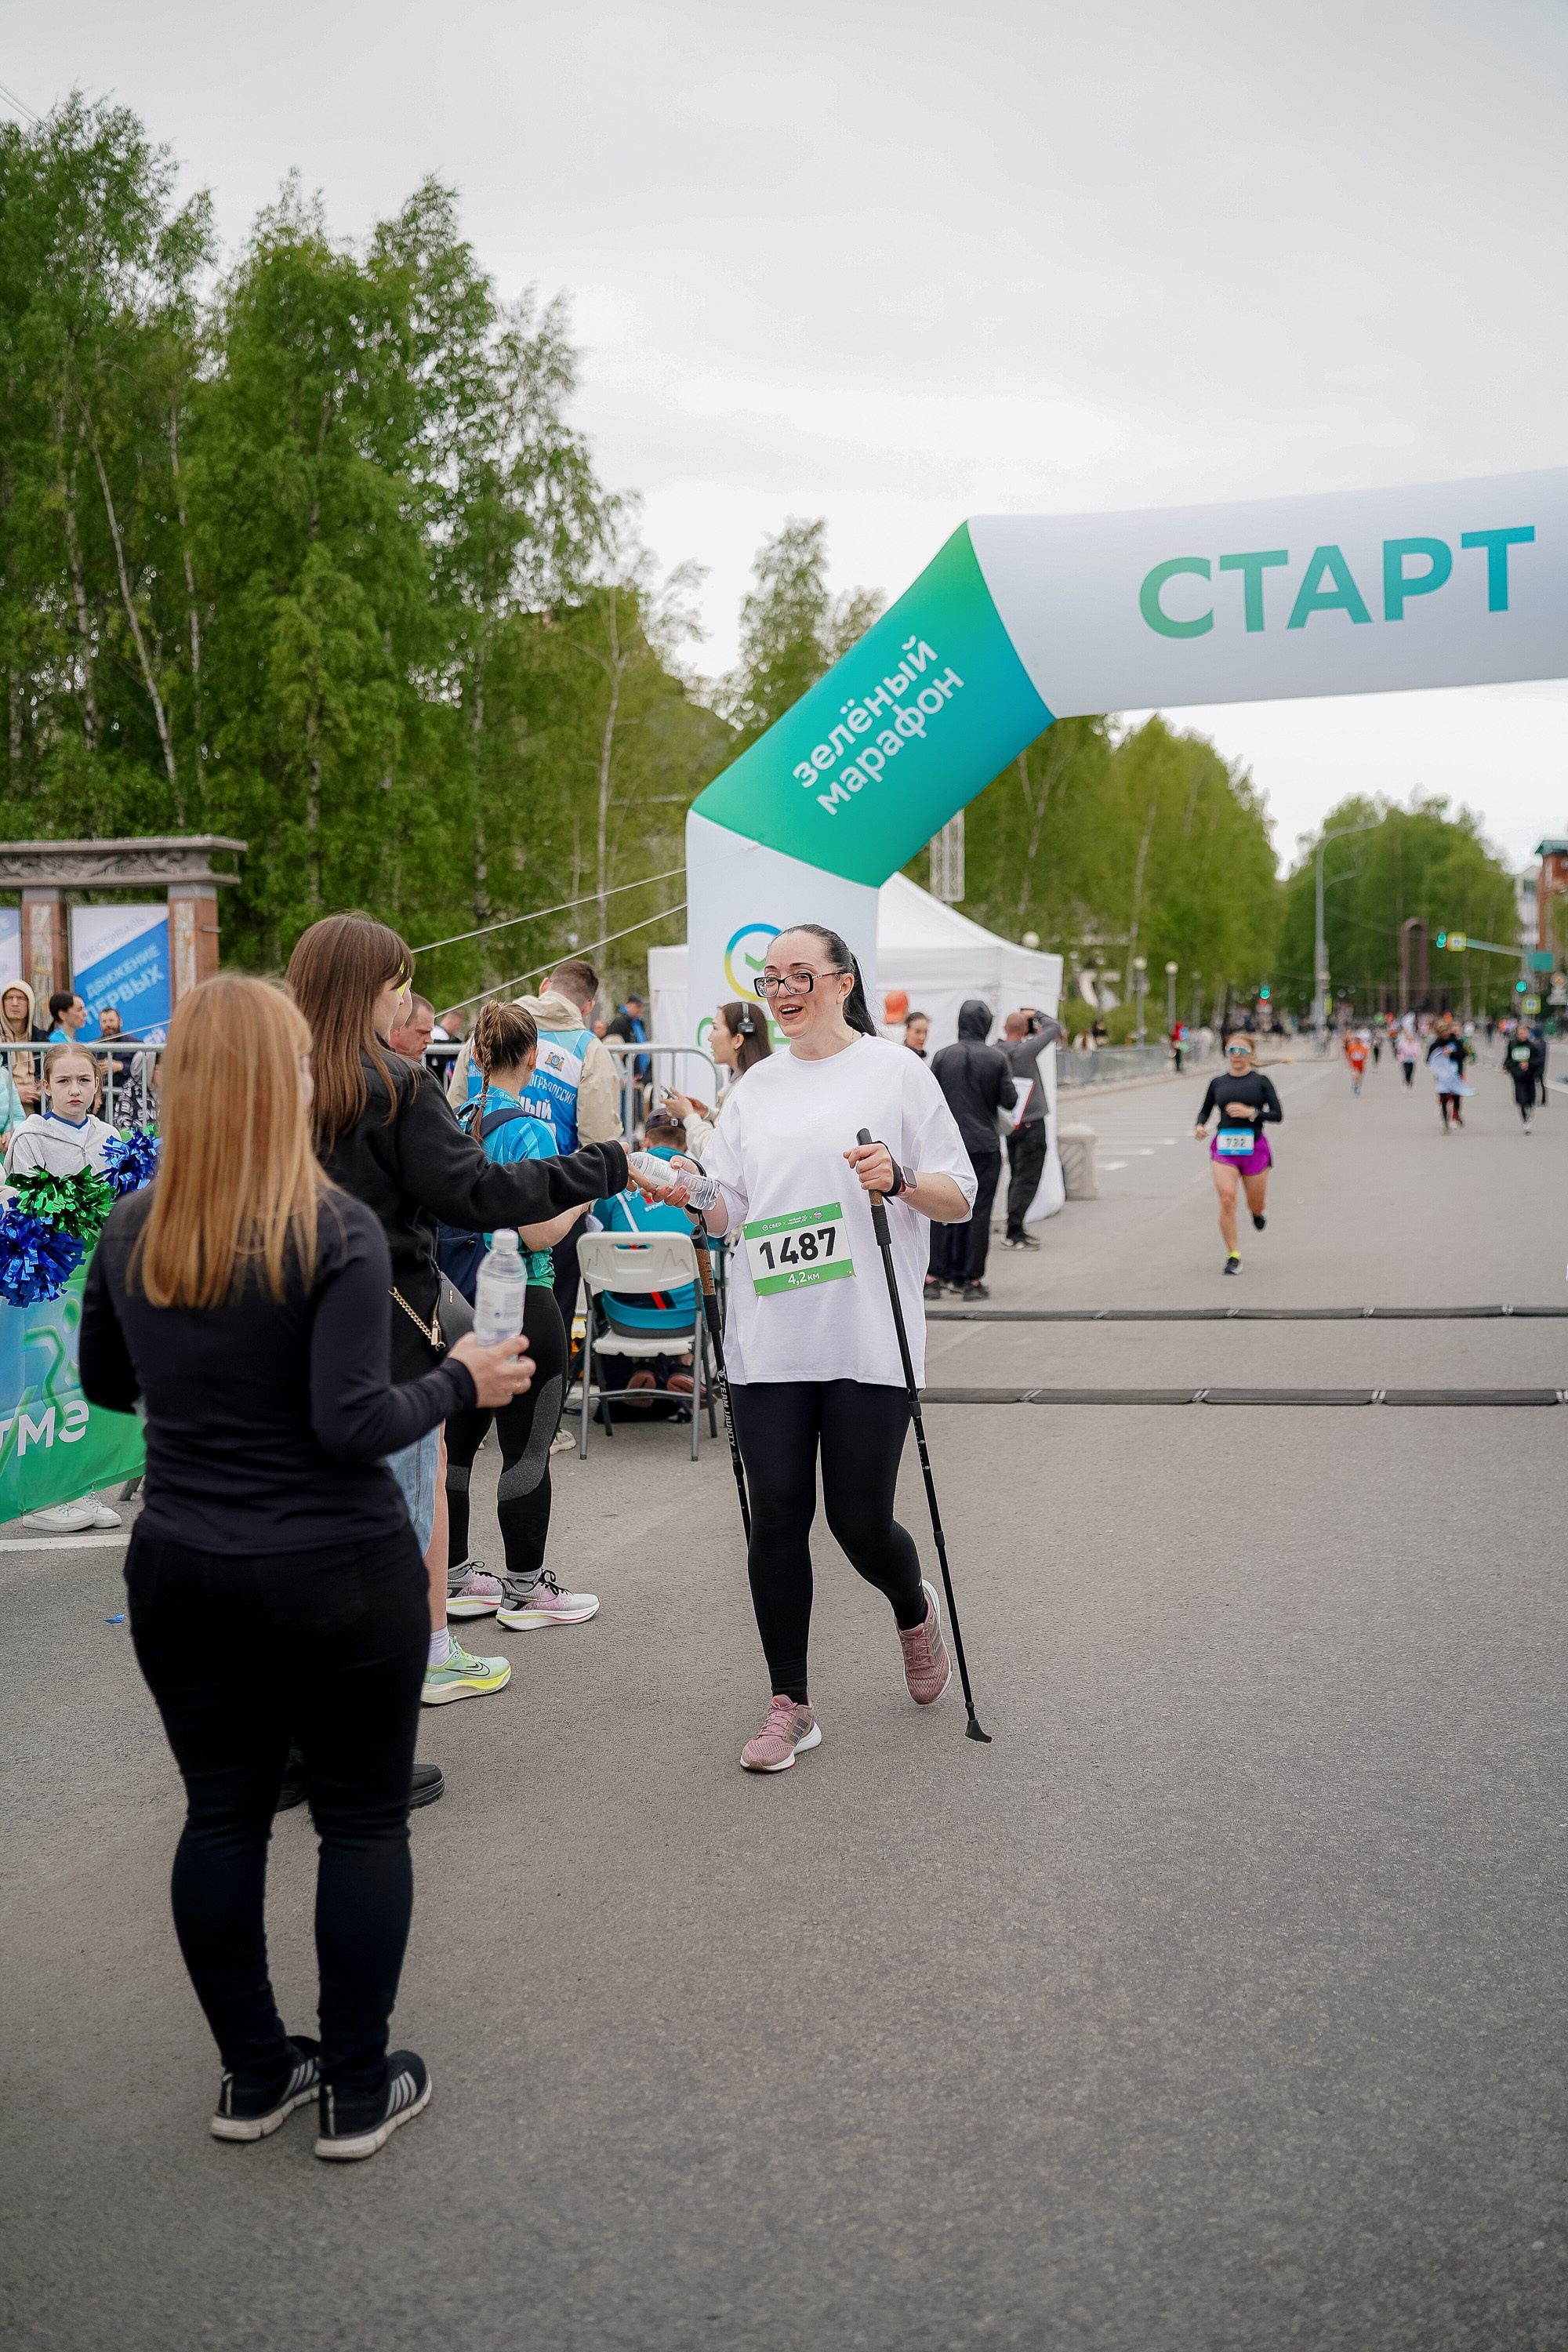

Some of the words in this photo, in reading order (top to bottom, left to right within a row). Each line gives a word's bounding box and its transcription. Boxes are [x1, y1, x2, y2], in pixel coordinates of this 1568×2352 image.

[1138, 525, 1536, 640] СТАРТ
[793, 634, 938, 789] зелёный
[816, 667, 965, 816] марафон
[85, 943, 162, 1001] ДВИЖЕНИЕ
[85, 963, 165, 1025] ПЕРВЫХ
[759, 1226, 837, 1270] 1487
[720, 1381, 729, 1408] TEAM
[724, 1409, 735, 1446] JAUNTY
